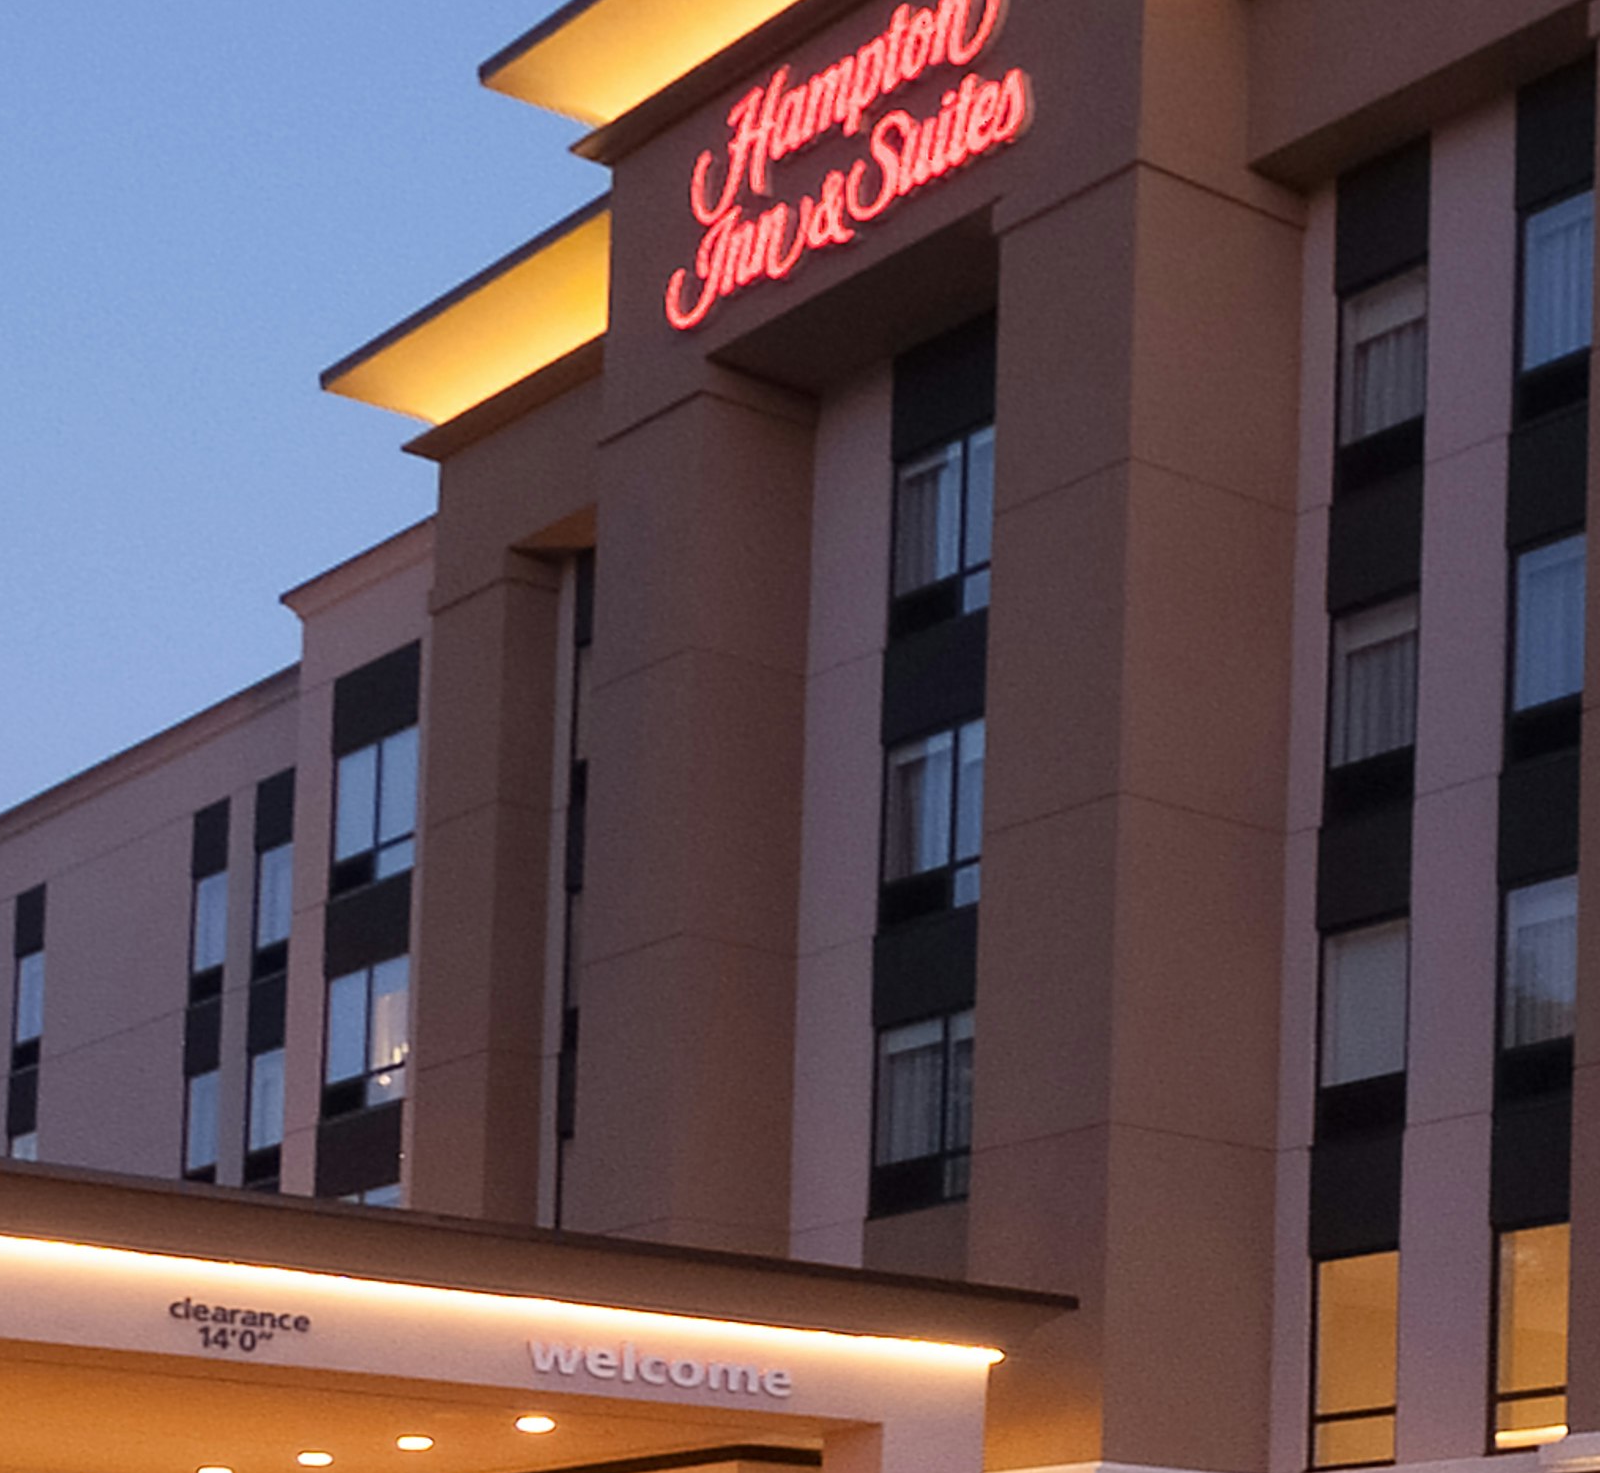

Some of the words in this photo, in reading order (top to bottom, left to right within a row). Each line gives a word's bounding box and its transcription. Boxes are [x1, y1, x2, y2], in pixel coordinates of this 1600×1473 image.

[665, 205, 805, 329] Inn
[805, 170, 855, 249] &
[846, 68, 1027, 221] Suites
[169, 1297, 311, 1333] clearance
[528, 1341, 794, 1398] welcome
